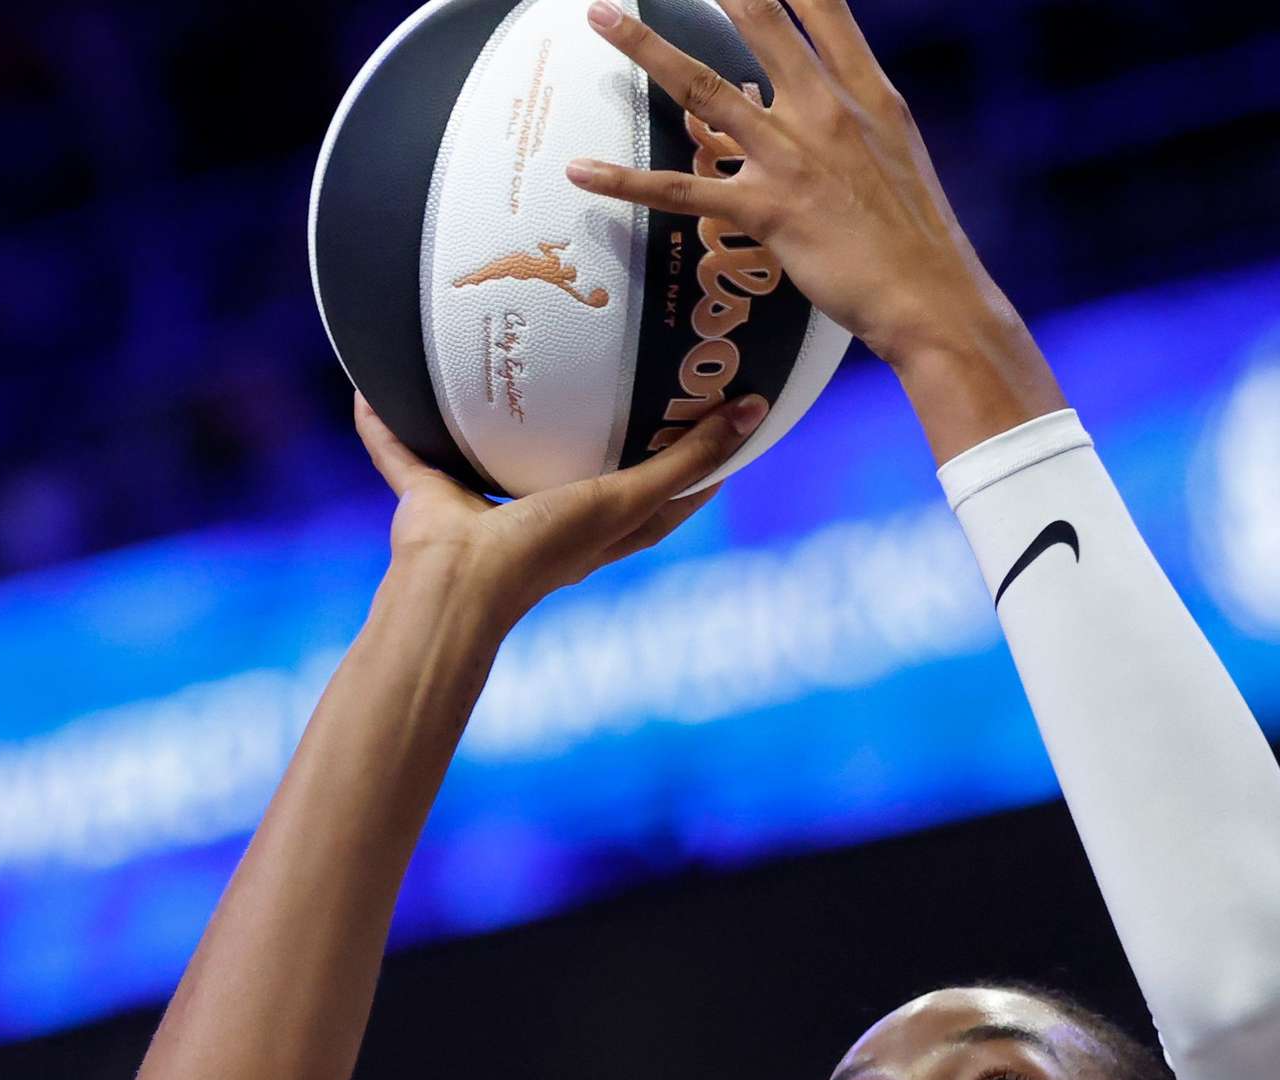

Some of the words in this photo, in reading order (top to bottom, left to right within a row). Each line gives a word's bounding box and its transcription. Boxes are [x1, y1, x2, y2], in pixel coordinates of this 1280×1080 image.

[505, 98, 523, 142] BALL
[514, 38, 552, 173] COMMISSIONER'S
[530, 85, 555, 158] OFFICIAL
[509, 175, 524, 216] CUP
[669, 231, 682, 275] EVO
[663, 284, 679, 329] NXT
